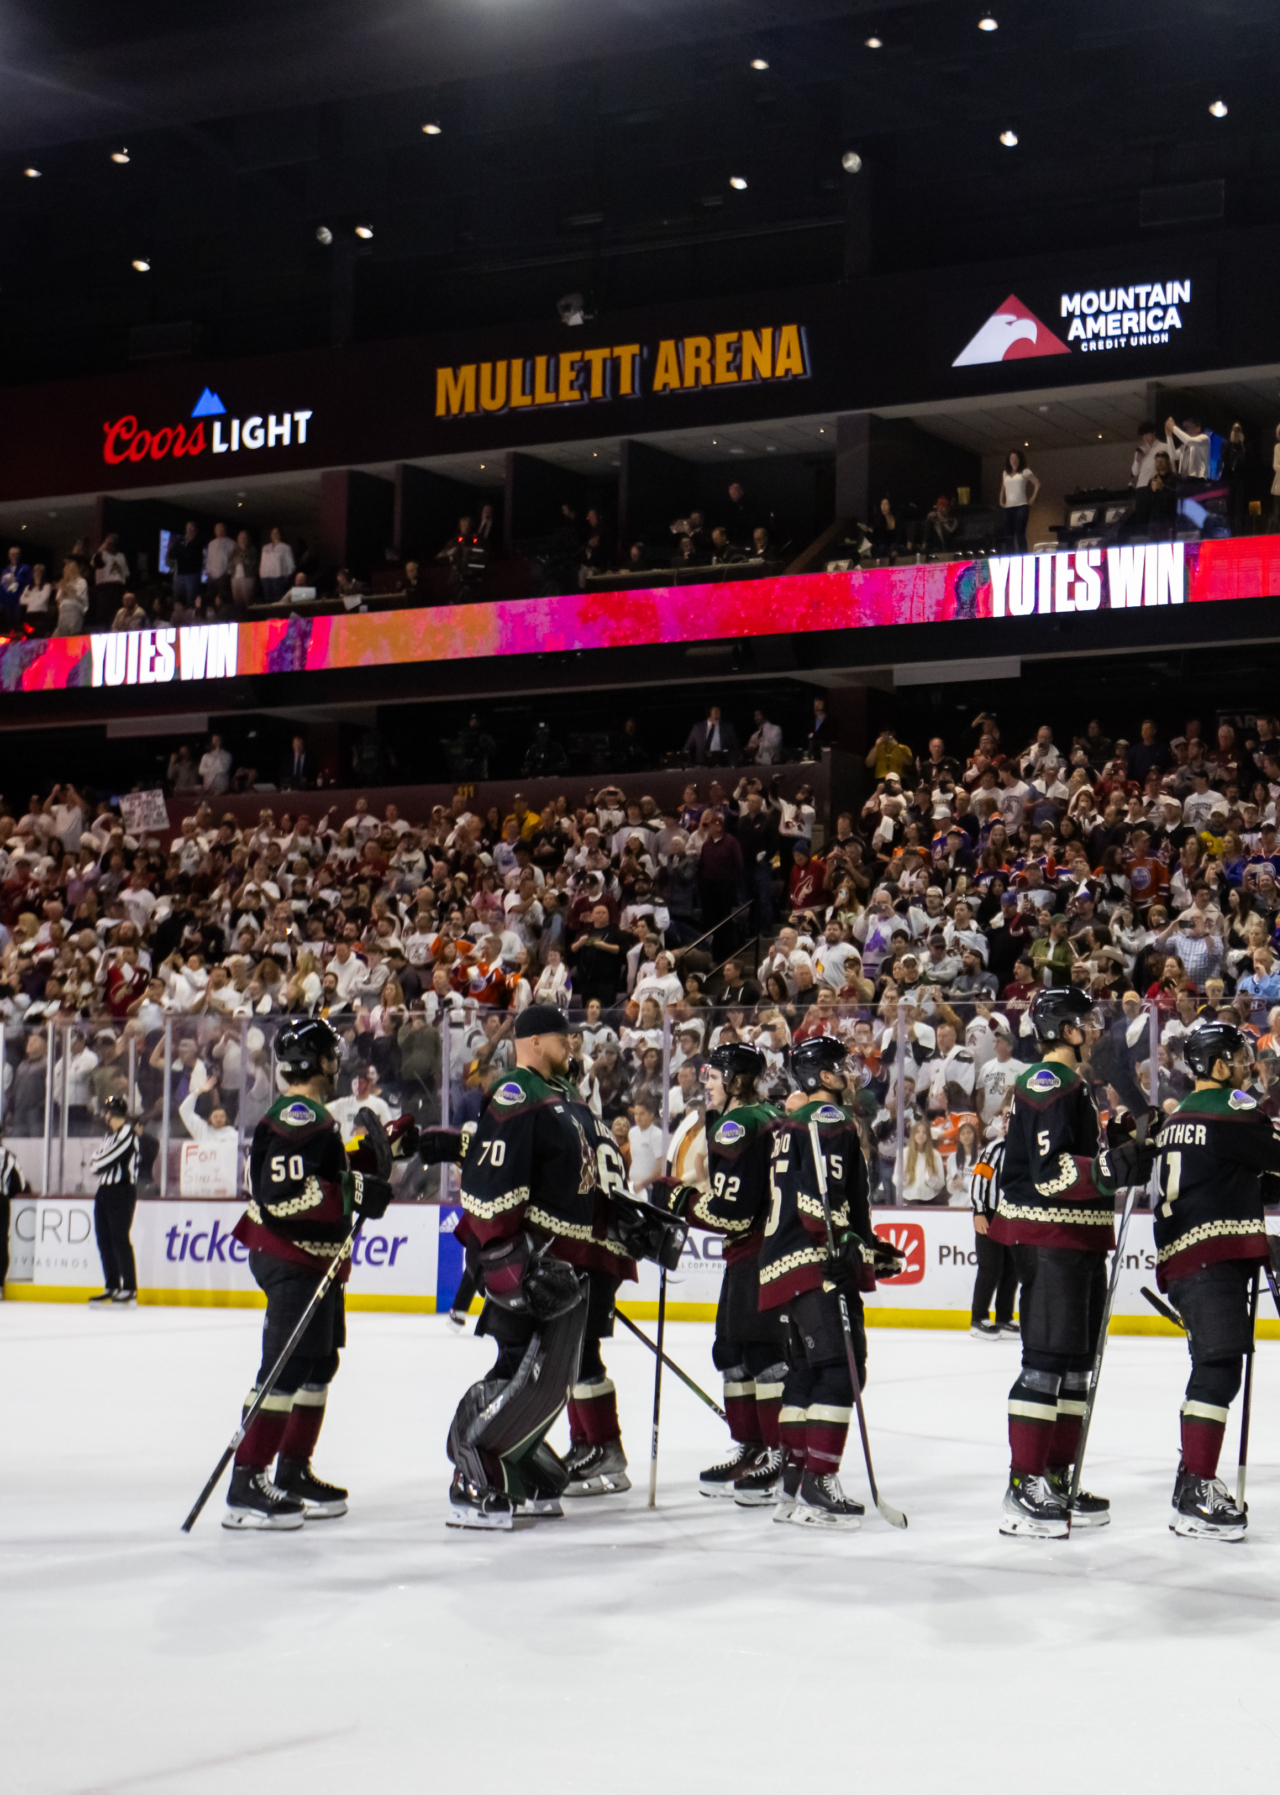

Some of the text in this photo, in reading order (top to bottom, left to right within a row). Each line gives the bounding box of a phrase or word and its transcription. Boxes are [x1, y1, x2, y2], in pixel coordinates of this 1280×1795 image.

[1061, 279, 1191, 317] MOUNTAIN
[1067, 306, 1182, 341] AMERICA
[1081, 332, 1169, 352] CREDIT UNION
[434, 324, 810, 419] MULLETT ARENA
[103, 410, 312, 465] Coors LIGHT
[1107, 542, 1185, 608] WIN
[179, 622, 239, 681] WIN
[477, 1140, 506, 1167] 70
[1037, 1130, 1050, 1156] 5
[271, 1154, 304, 1183] 50
[713, 1172, 740, 1202] 92
